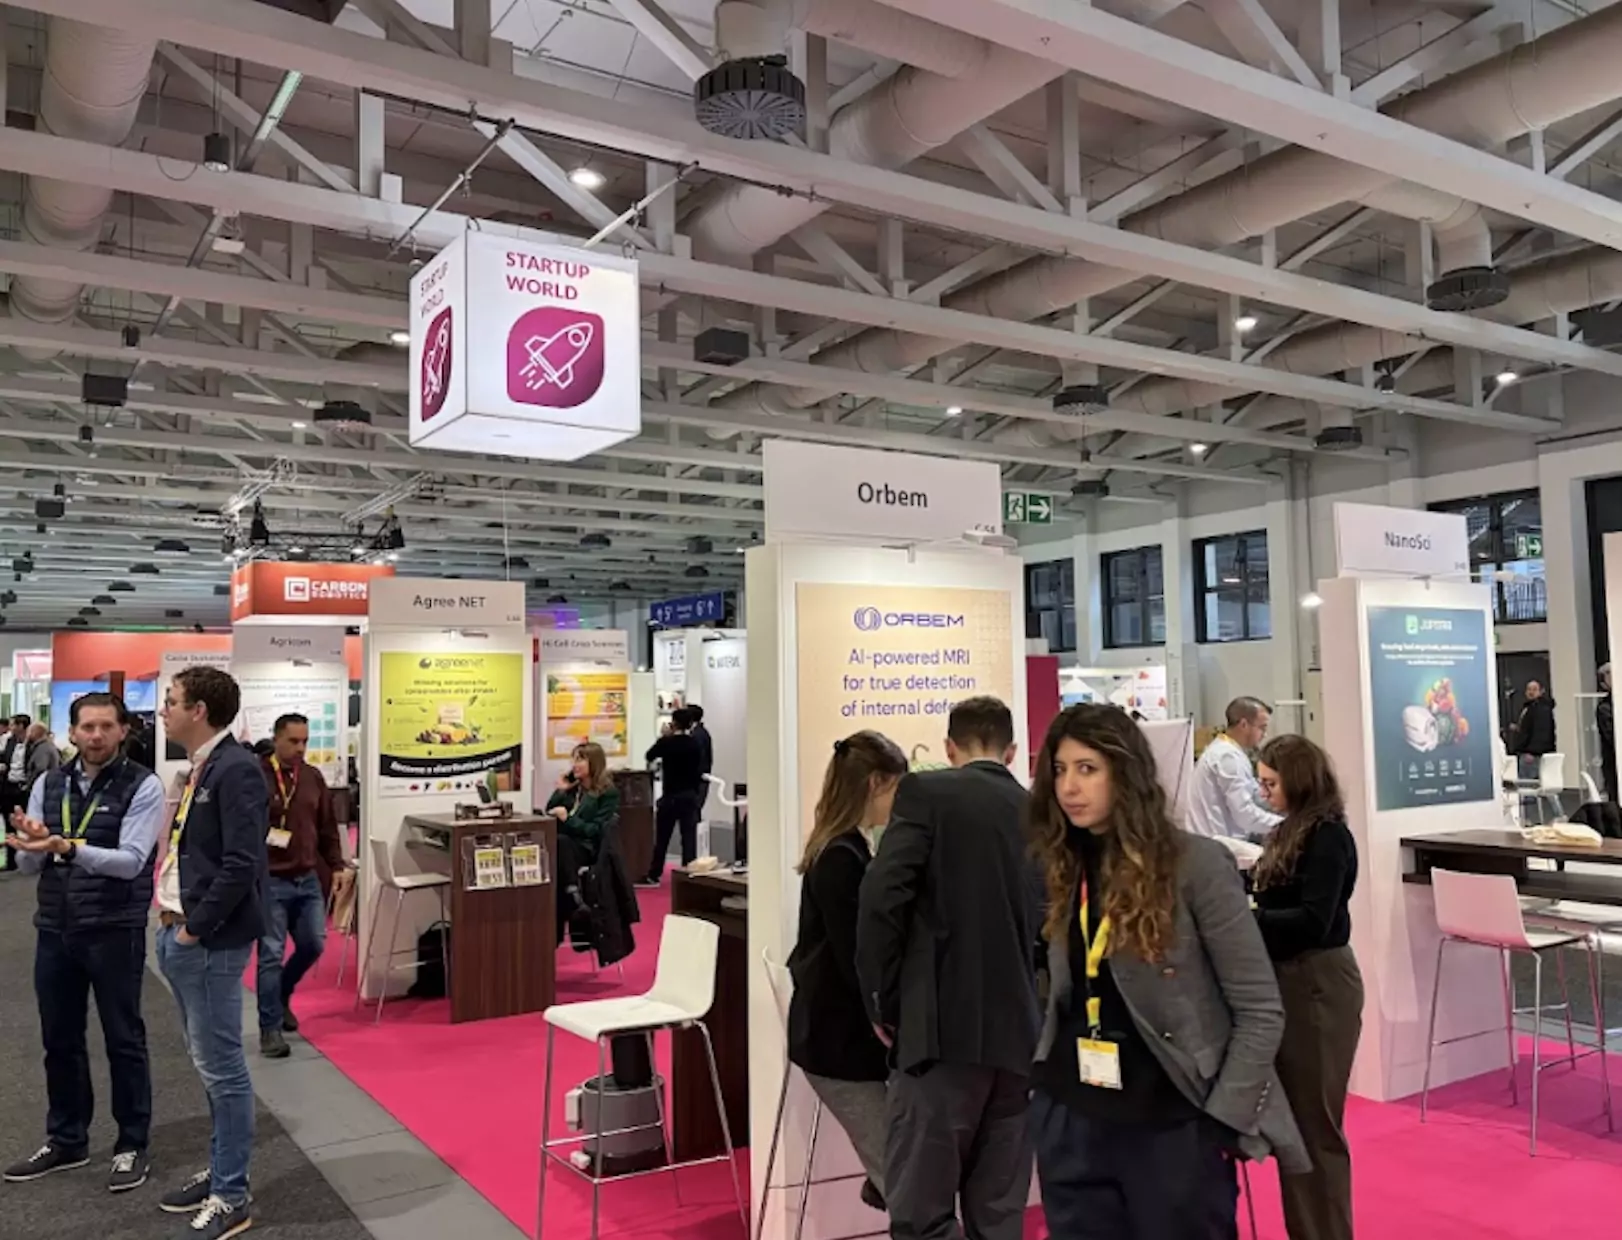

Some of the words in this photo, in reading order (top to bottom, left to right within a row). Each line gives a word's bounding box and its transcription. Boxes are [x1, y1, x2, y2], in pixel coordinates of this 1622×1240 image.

[506, 251, 590, 279] STARTUP
[506, 275, 578, 301] WORLD
[857, 481, 929, 508] Orbem
[1384, 531, 1431, 550] NanoSci
[311, 581, 367, 592] CARBON
[412, 594, 456, 609] Agree
[459, 596, 486, 608] NET
[884, 613, 964, 628] ORBEM
[849, 649, 939, 667] AI-powered
[943, 650, 970, 664] MRI
[843, 674, 865, 691] for
[869, 676, 901, 690] true
[905, 675, 976, 691] detection
[841, 700, 857, 718] of
[861, 699, 920, 717] internal
